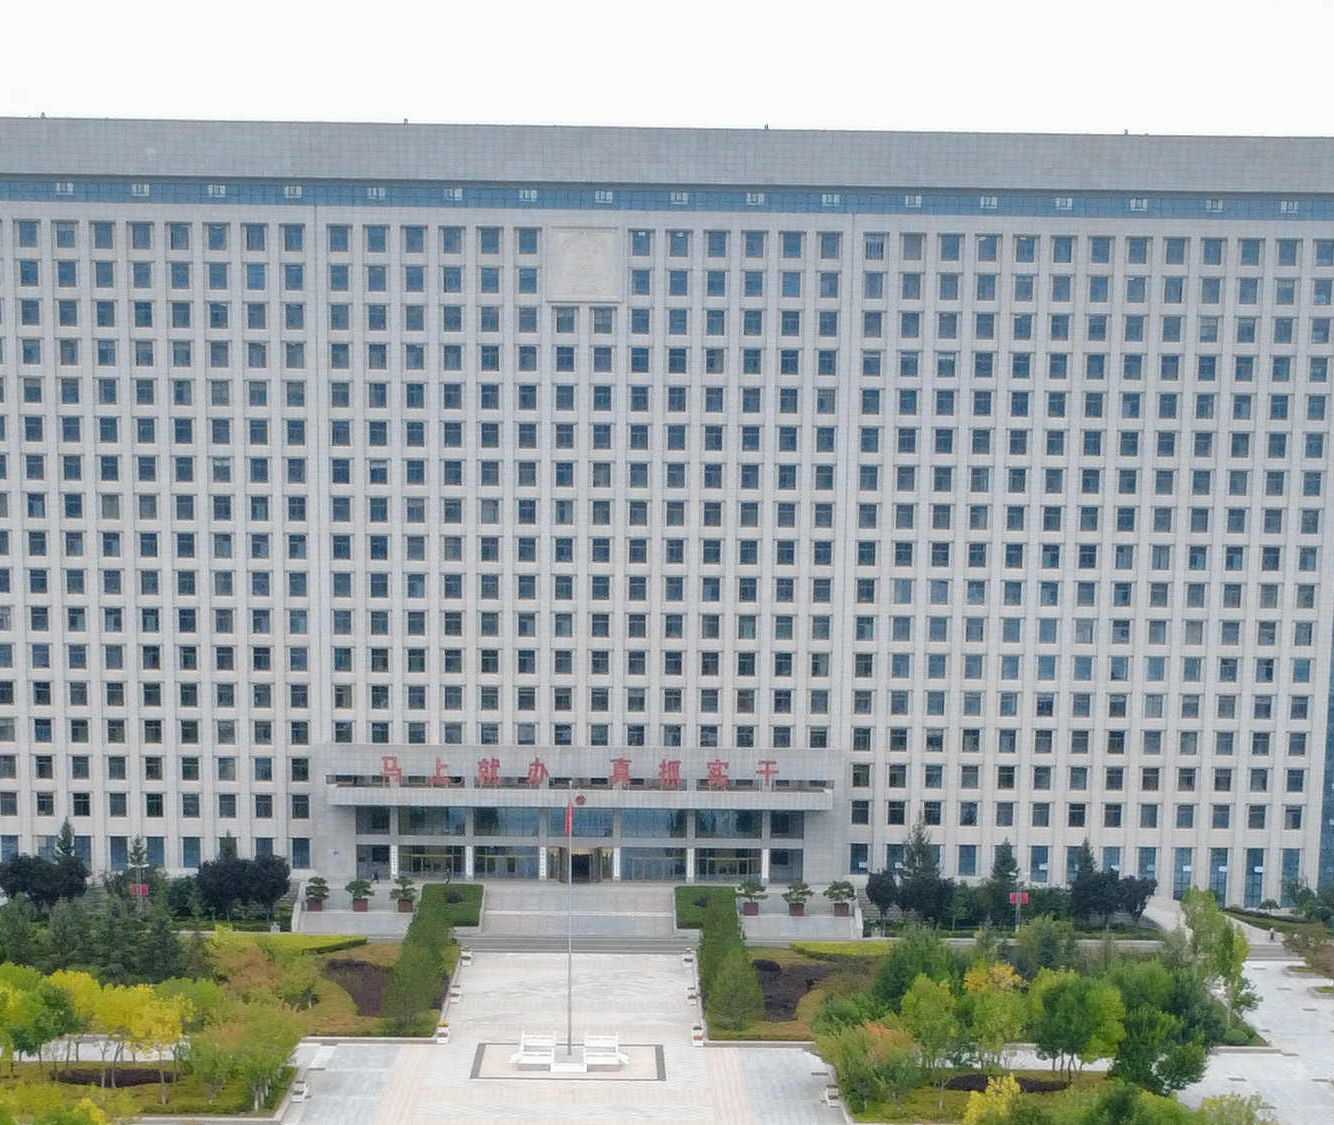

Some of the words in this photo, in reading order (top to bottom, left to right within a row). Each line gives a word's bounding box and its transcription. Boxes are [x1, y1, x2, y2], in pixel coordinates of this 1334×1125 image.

[382, 756, 549, 785] 马上就办
[611, 757, 779, 785] 真抓实干
